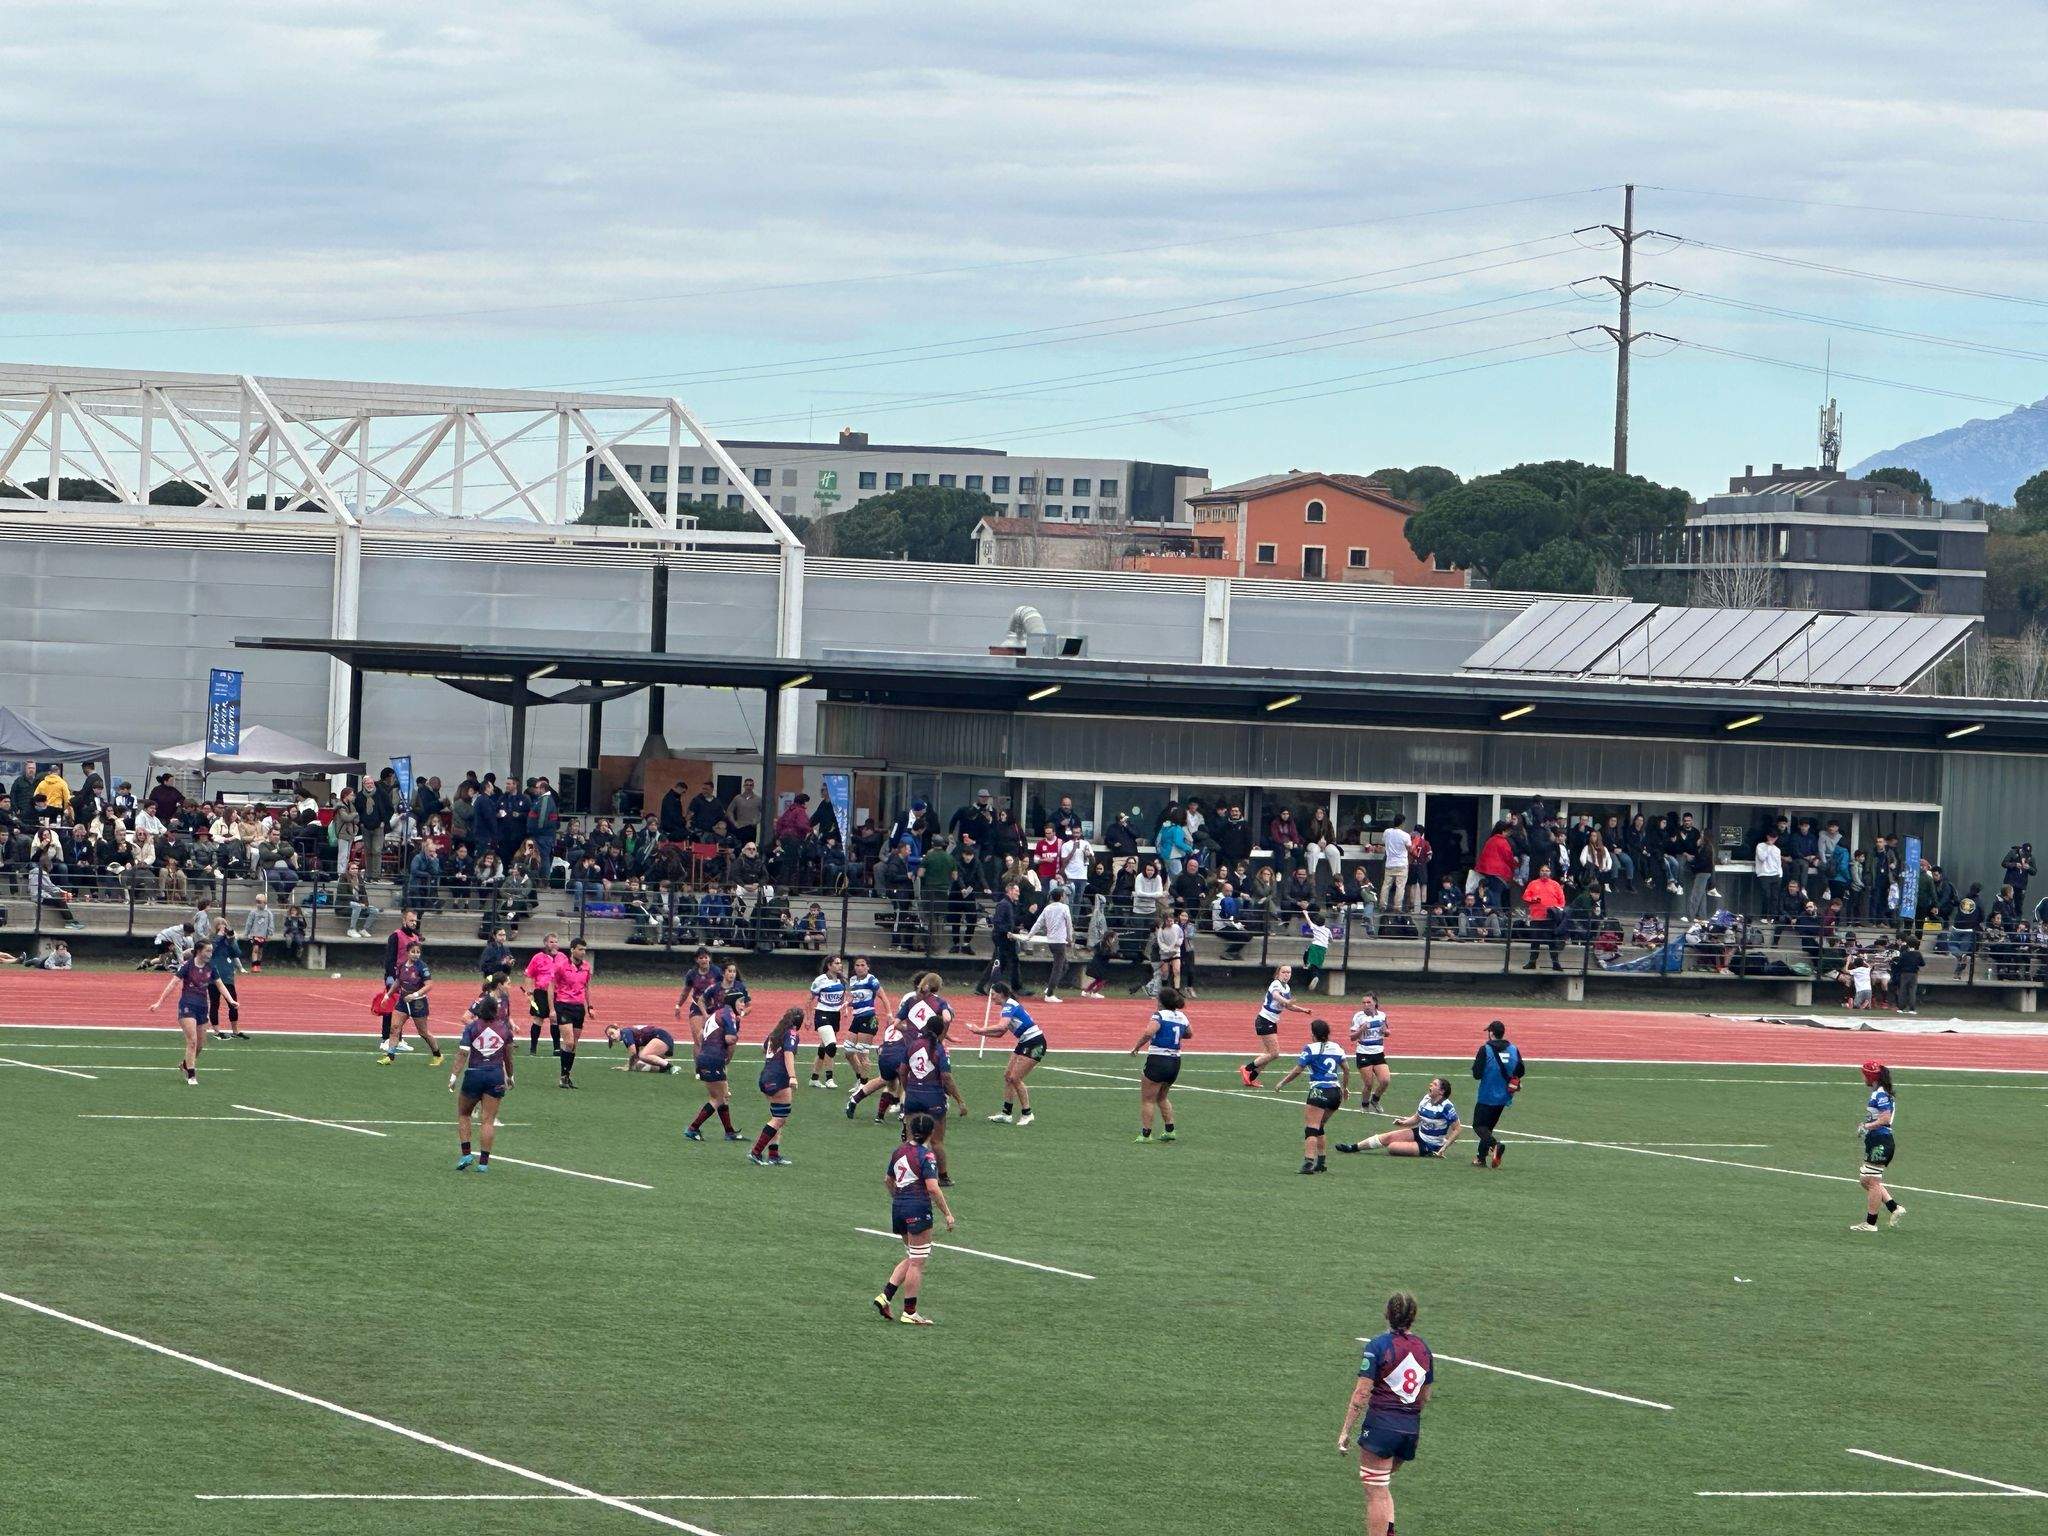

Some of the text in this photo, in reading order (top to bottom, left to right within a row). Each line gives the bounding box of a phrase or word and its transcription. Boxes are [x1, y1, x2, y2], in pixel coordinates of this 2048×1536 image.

[915, 1008, 926, 1021] 4
[479, 1035, 500, 1049] 12
[1172, 1025, 1180, 1044] 1
[1323, 1057, 1337, 1077] 2
[897, 1165, 907, 1182] 7
[1402, 1368, 1418, 1394] 8
